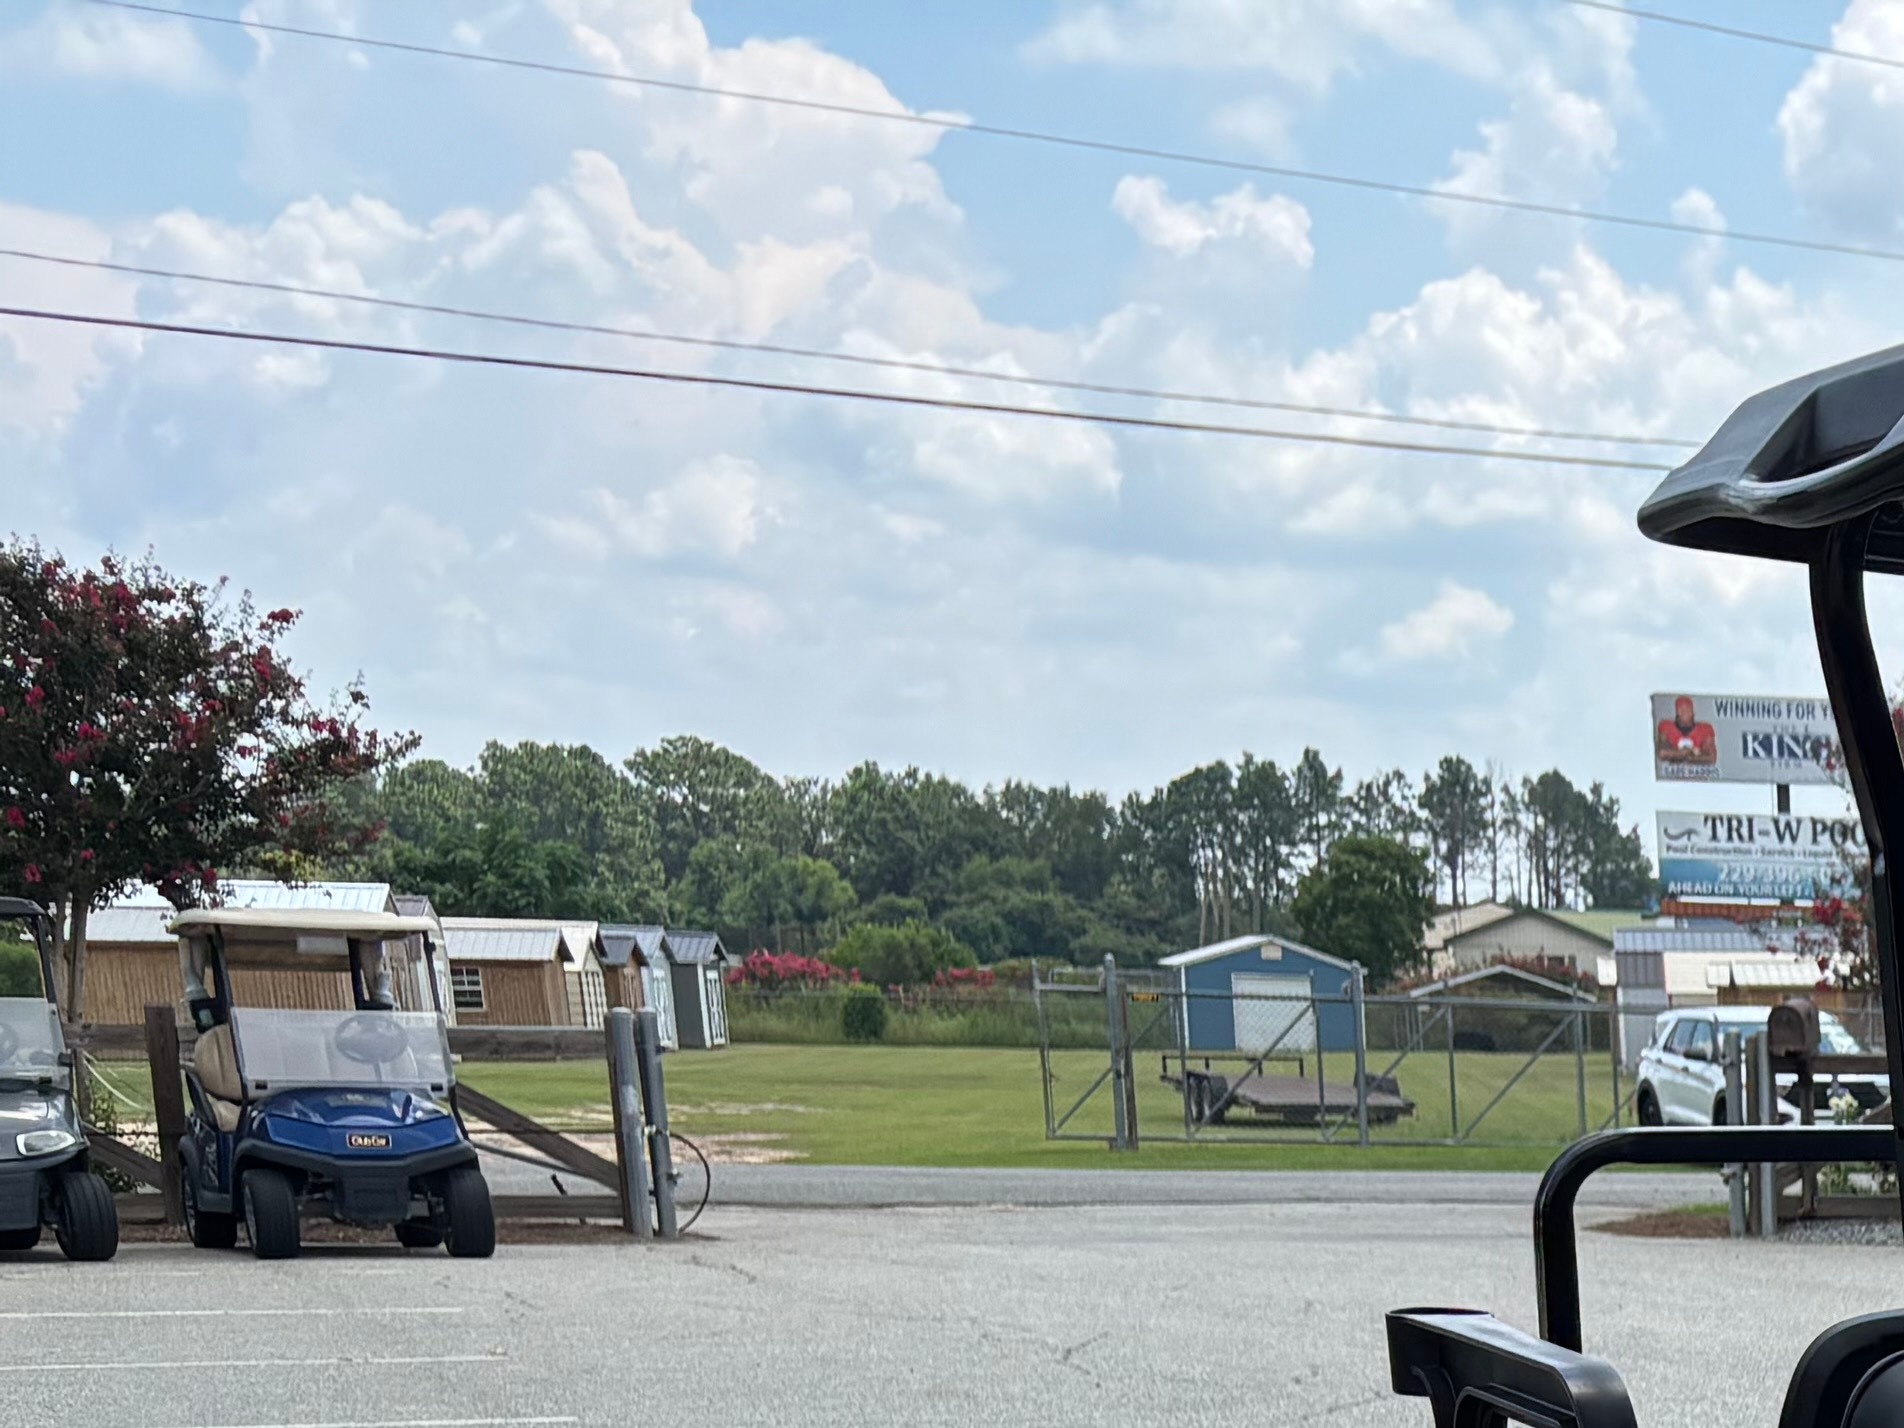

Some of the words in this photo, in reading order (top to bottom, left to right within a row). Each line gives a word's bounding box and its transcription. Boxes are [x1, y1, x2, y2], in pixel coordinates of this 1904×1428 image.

[1713, 698, 1782, 720] WINNING
[1785, 700, 1816, 721] FOR
[1703, 815, 1803, 844] TRI-W
[1810, 817, 1868, 848] POO
